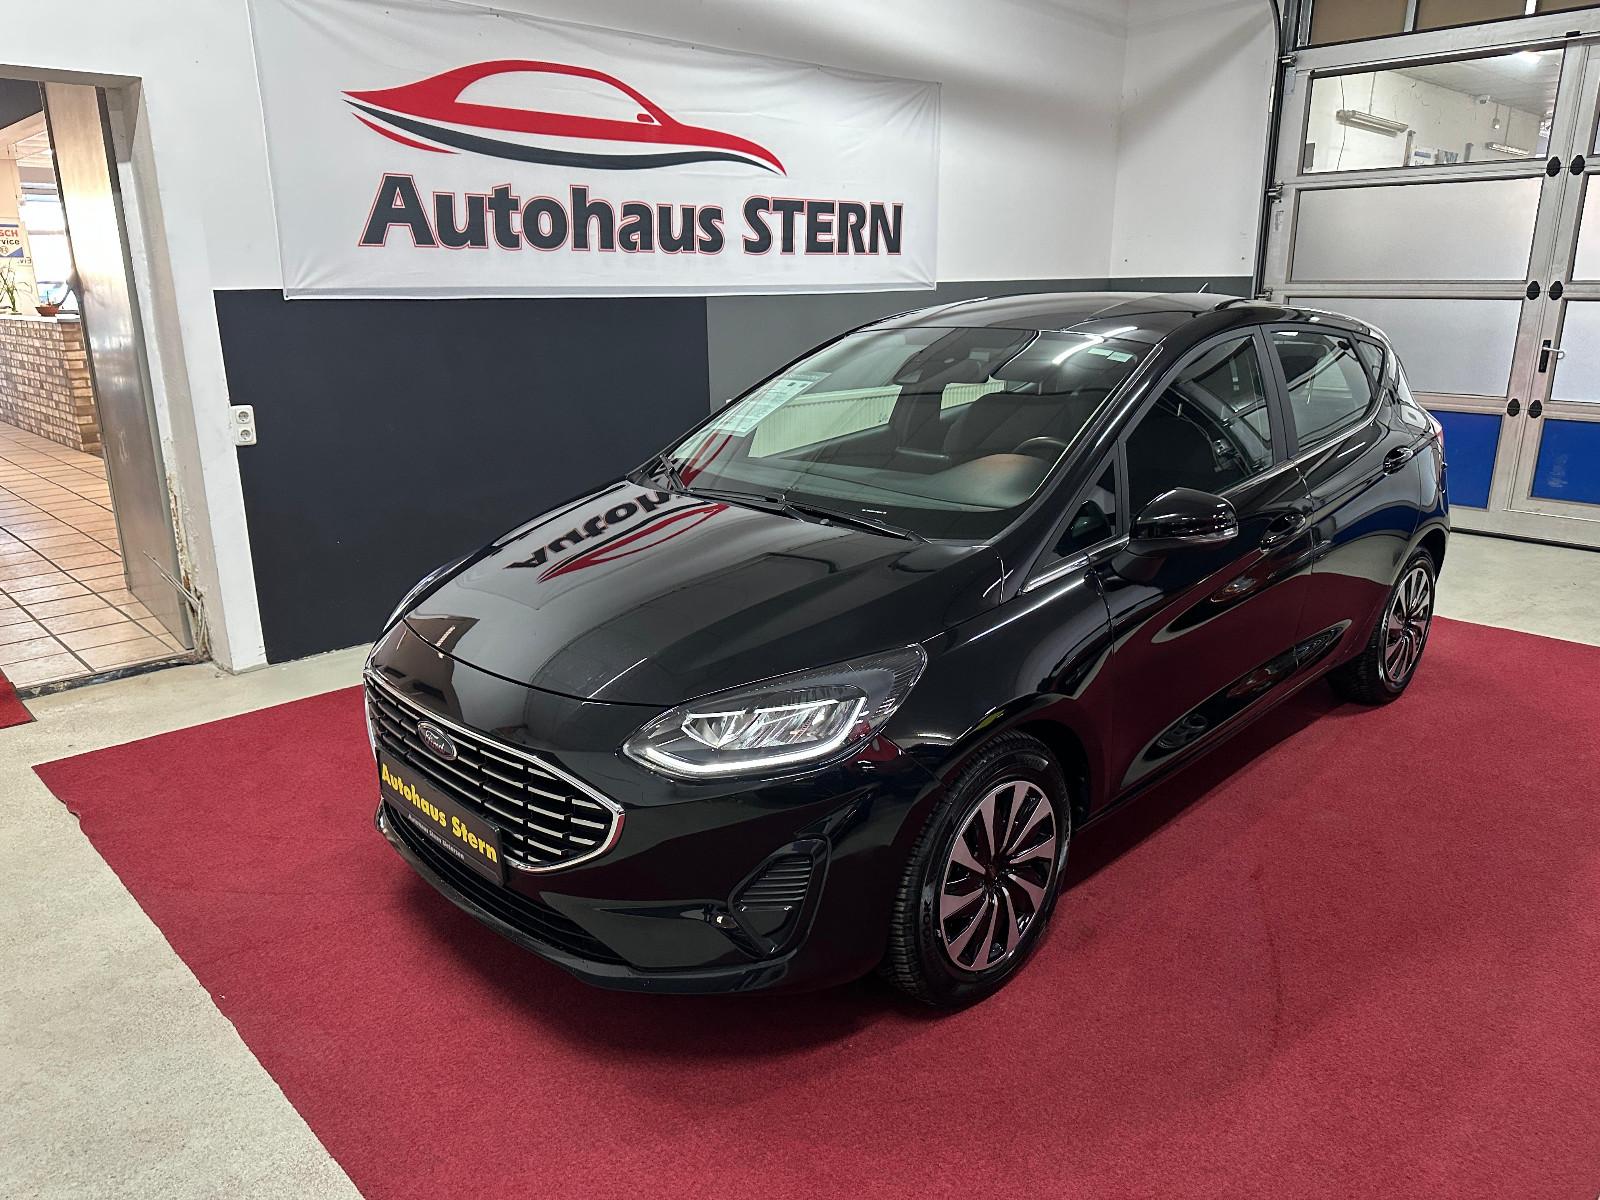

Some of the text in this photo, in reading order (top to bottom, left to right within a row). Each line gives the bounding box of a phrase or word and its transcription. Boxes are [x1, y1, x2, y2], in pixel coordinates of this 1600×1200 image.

[0, 229, 19, 237] SCH
[358, 173, 904, 256] Autohaus STERN
[381, 763, 497, 863] Autohaus Stern
